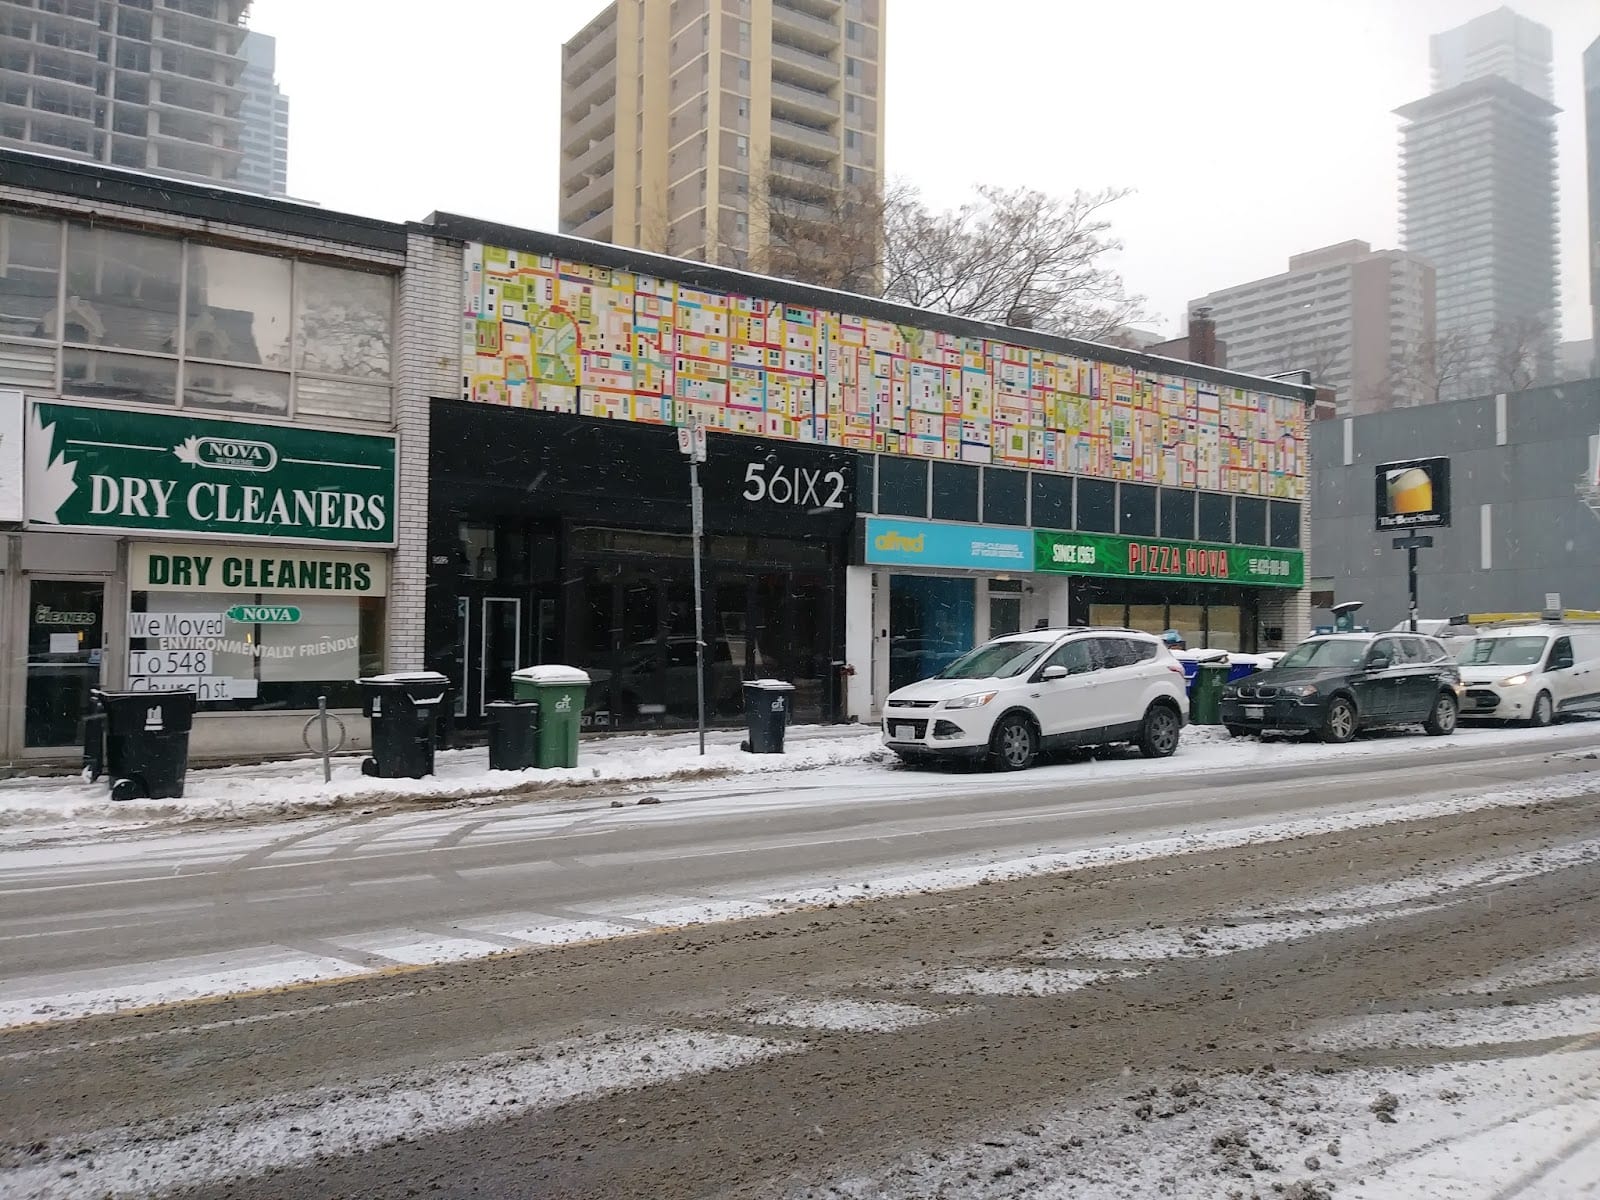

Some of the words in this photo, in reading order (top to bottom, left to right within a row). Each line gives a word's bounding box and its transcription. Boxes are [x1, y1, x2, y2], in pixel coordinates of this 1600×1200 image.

[207, 442, 263, 460] NOVA
[88, 474, 180, 518] DRY
[186, 481, 385, 531] CLEANERS
[1053, 544, 1077, 563] SINCE
[1128, 543, 1181, 574] PIZZA
[1186, 549, 1229, 579] NOVA
[148, 554, 214, 586] DRY
[222, 557, 372, 591] CLEANERS
[35, 611, 97, 625] CLEANERS
[131, 614, 161, 636] We
[164, 614, 223, 636] Moved
[242, 608, 292, 621] NOVA
[160, 637, 297, 659] ENVIRONMENTALLY
[300, 634, 359, 657] FRIENDLY
[131, 651, 161, 674] To
[166, 652, 207, 674] 548
